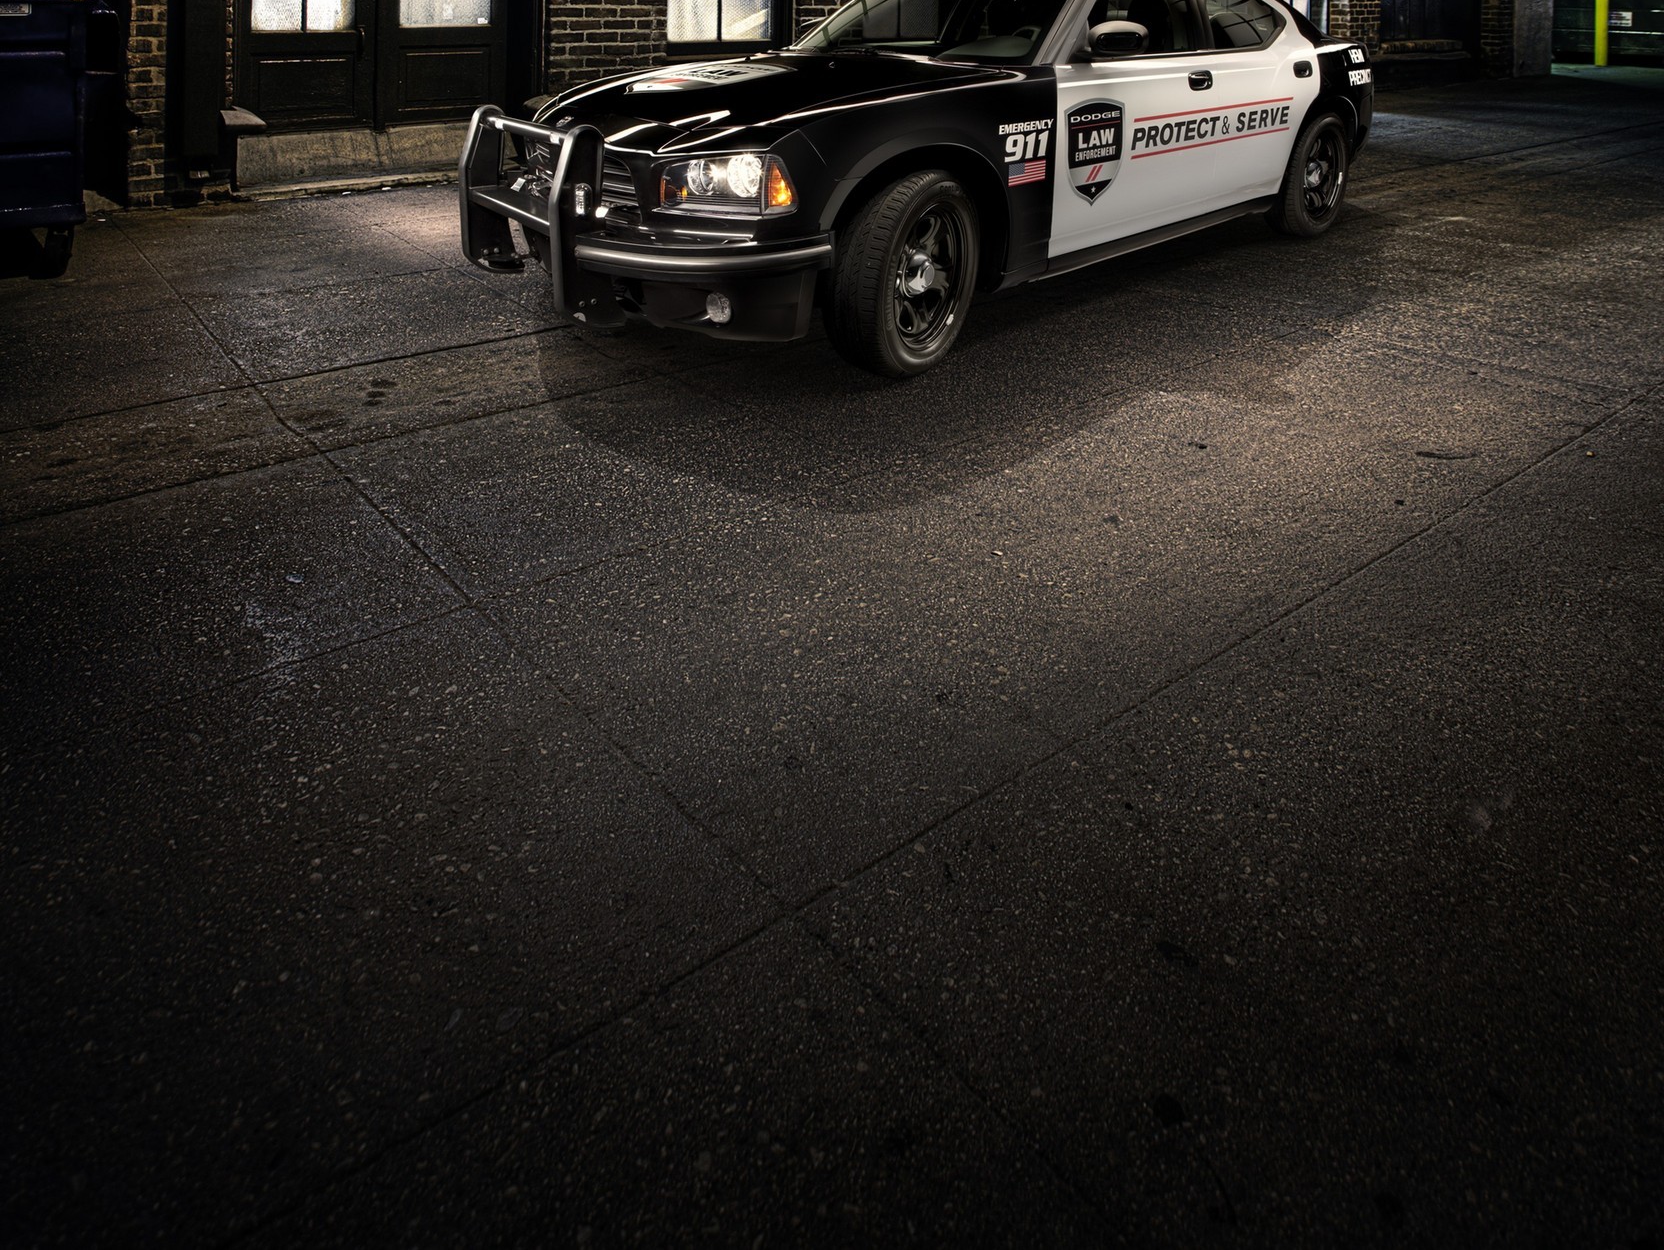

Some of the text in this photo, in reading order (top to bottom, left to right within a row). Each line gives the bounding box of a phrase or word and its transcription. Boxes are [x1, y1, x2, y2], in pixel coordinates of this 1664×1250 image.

[999, 118, 1054, 135] EMERGENCY
[1070, 110, 1121, 124] DODGE
[1131, 105, 1290, 151] PROTECT & SERVE
[1004, 130, 1050, 163] 911
[1077, 127, 1115, 150] LAW
[1075, 145, 1116, 162] ENFORCEMENT
